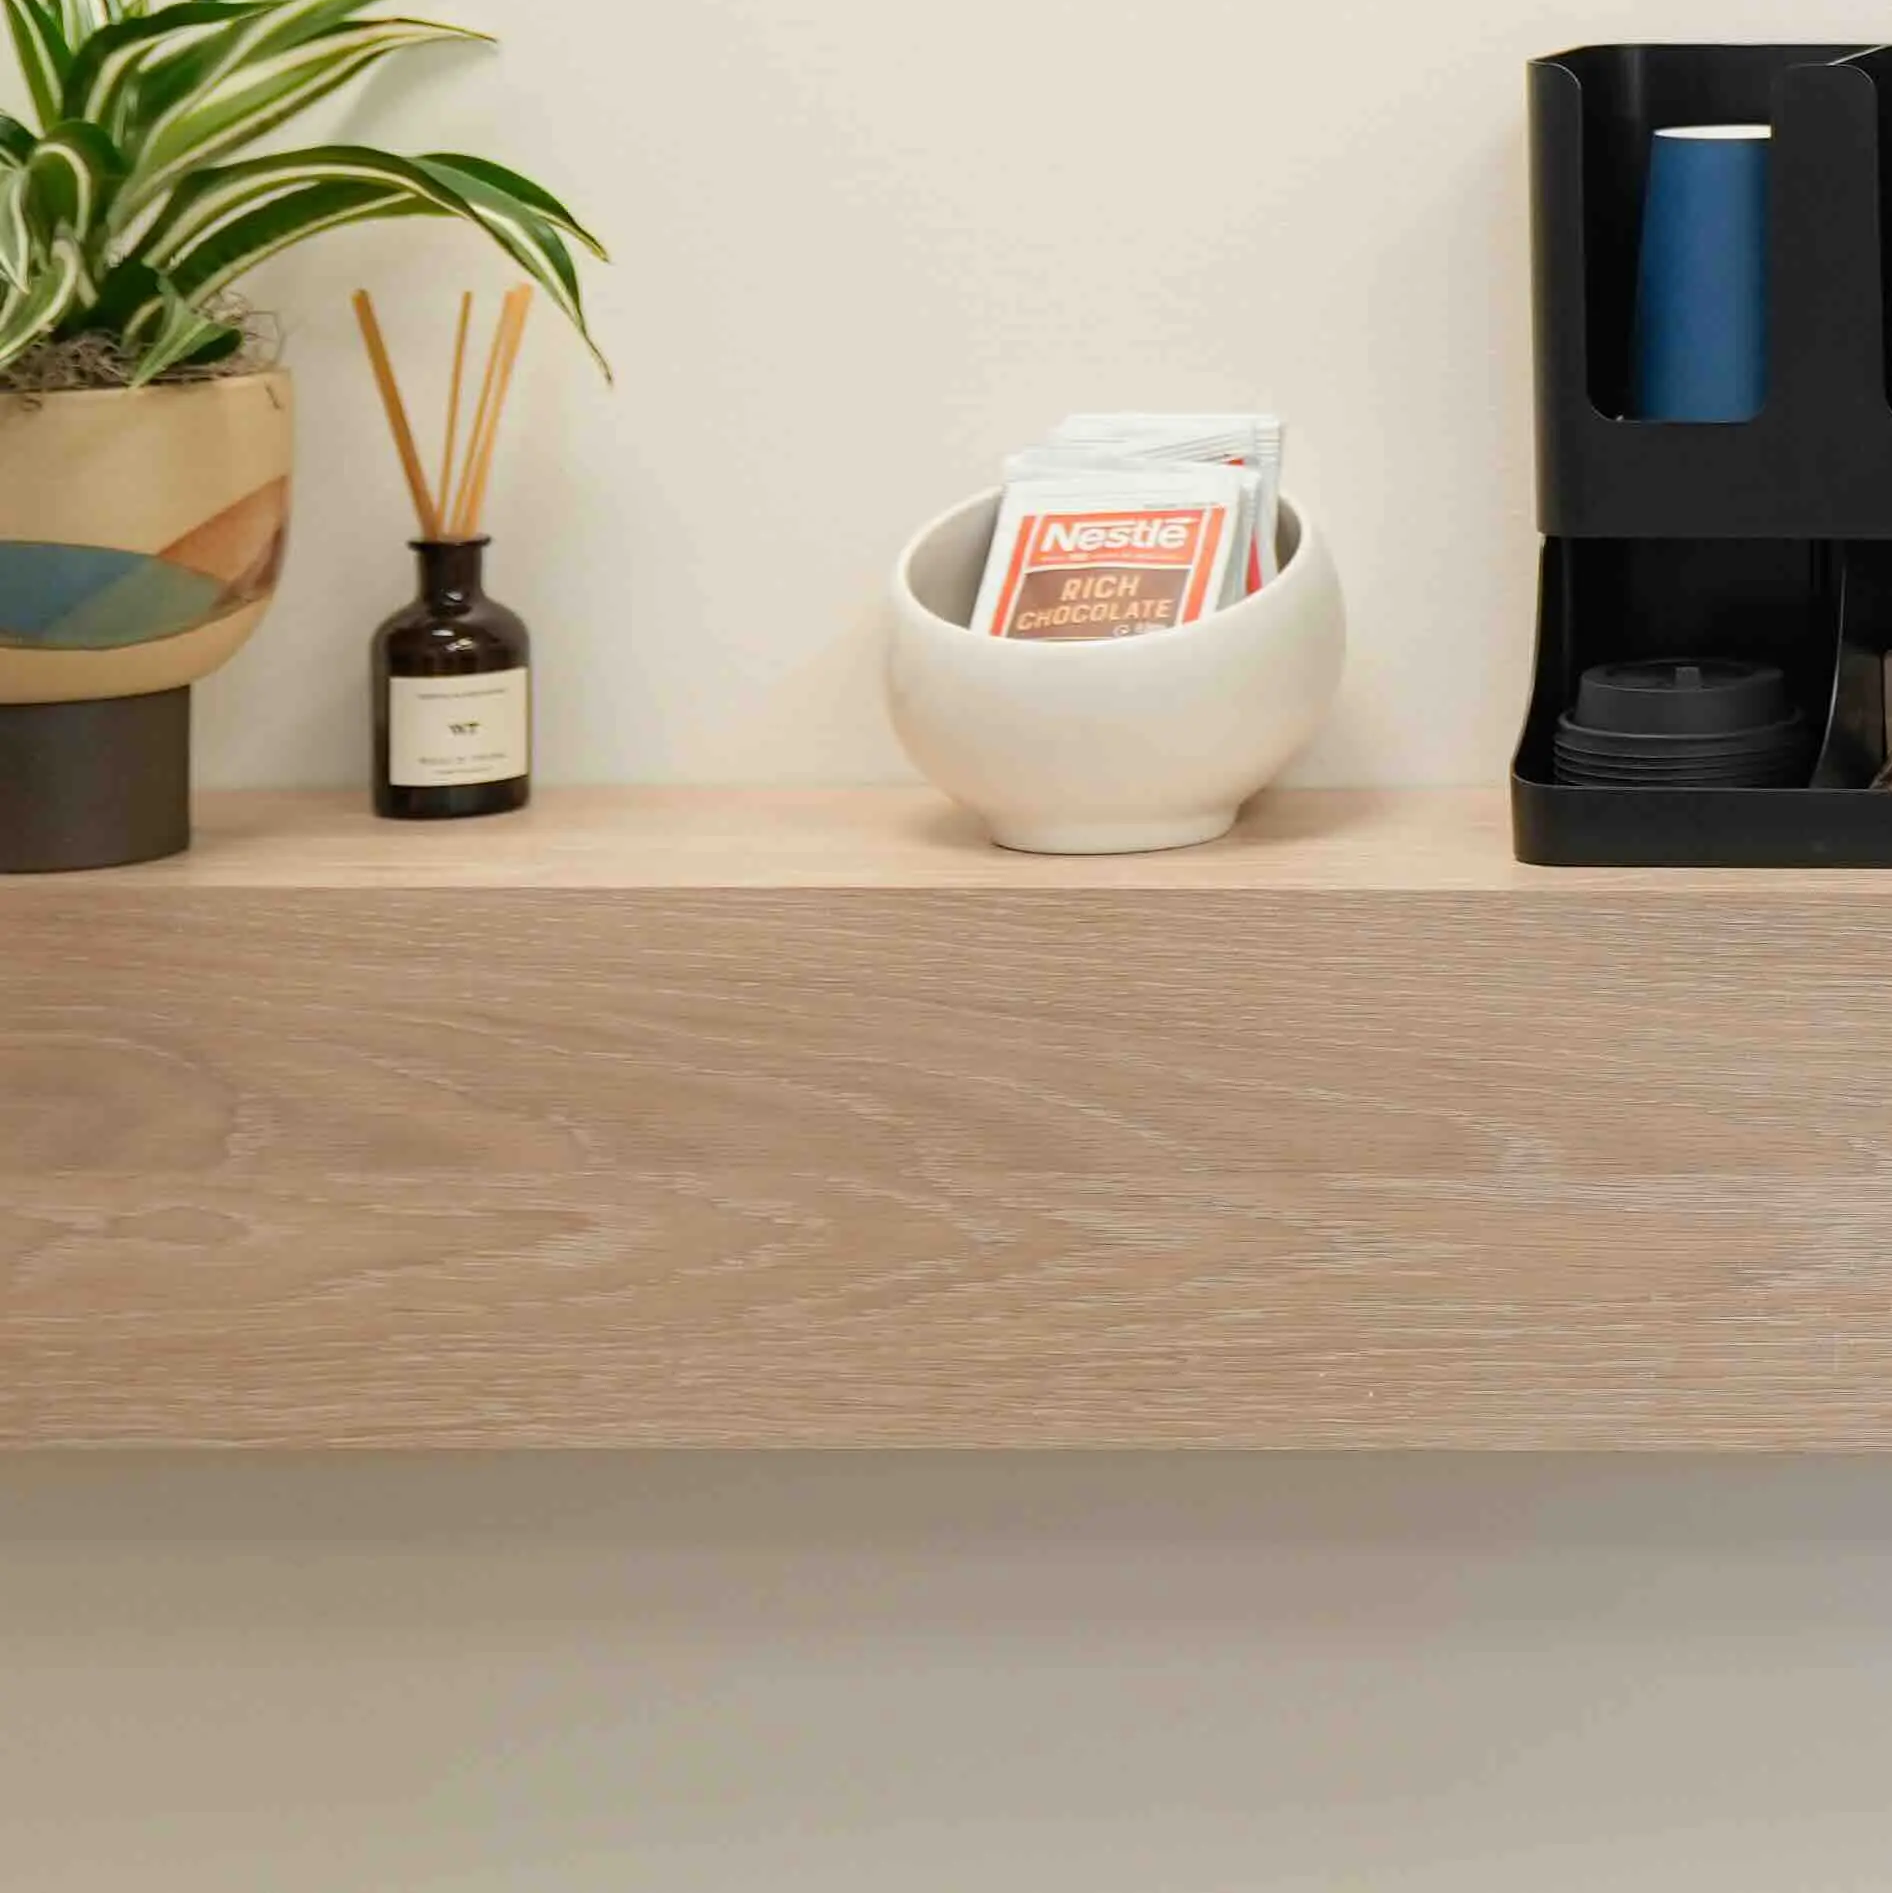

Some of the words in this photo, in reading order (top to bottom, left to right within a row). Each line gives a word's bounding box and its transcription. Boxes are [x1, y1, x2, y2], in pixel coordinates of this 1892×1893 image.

[1040, 517, 1201, 554] Nestlé
[1060, 574, 1142, 603] RICH
[1015, 598, 1176, 631] CHOCOLATE
